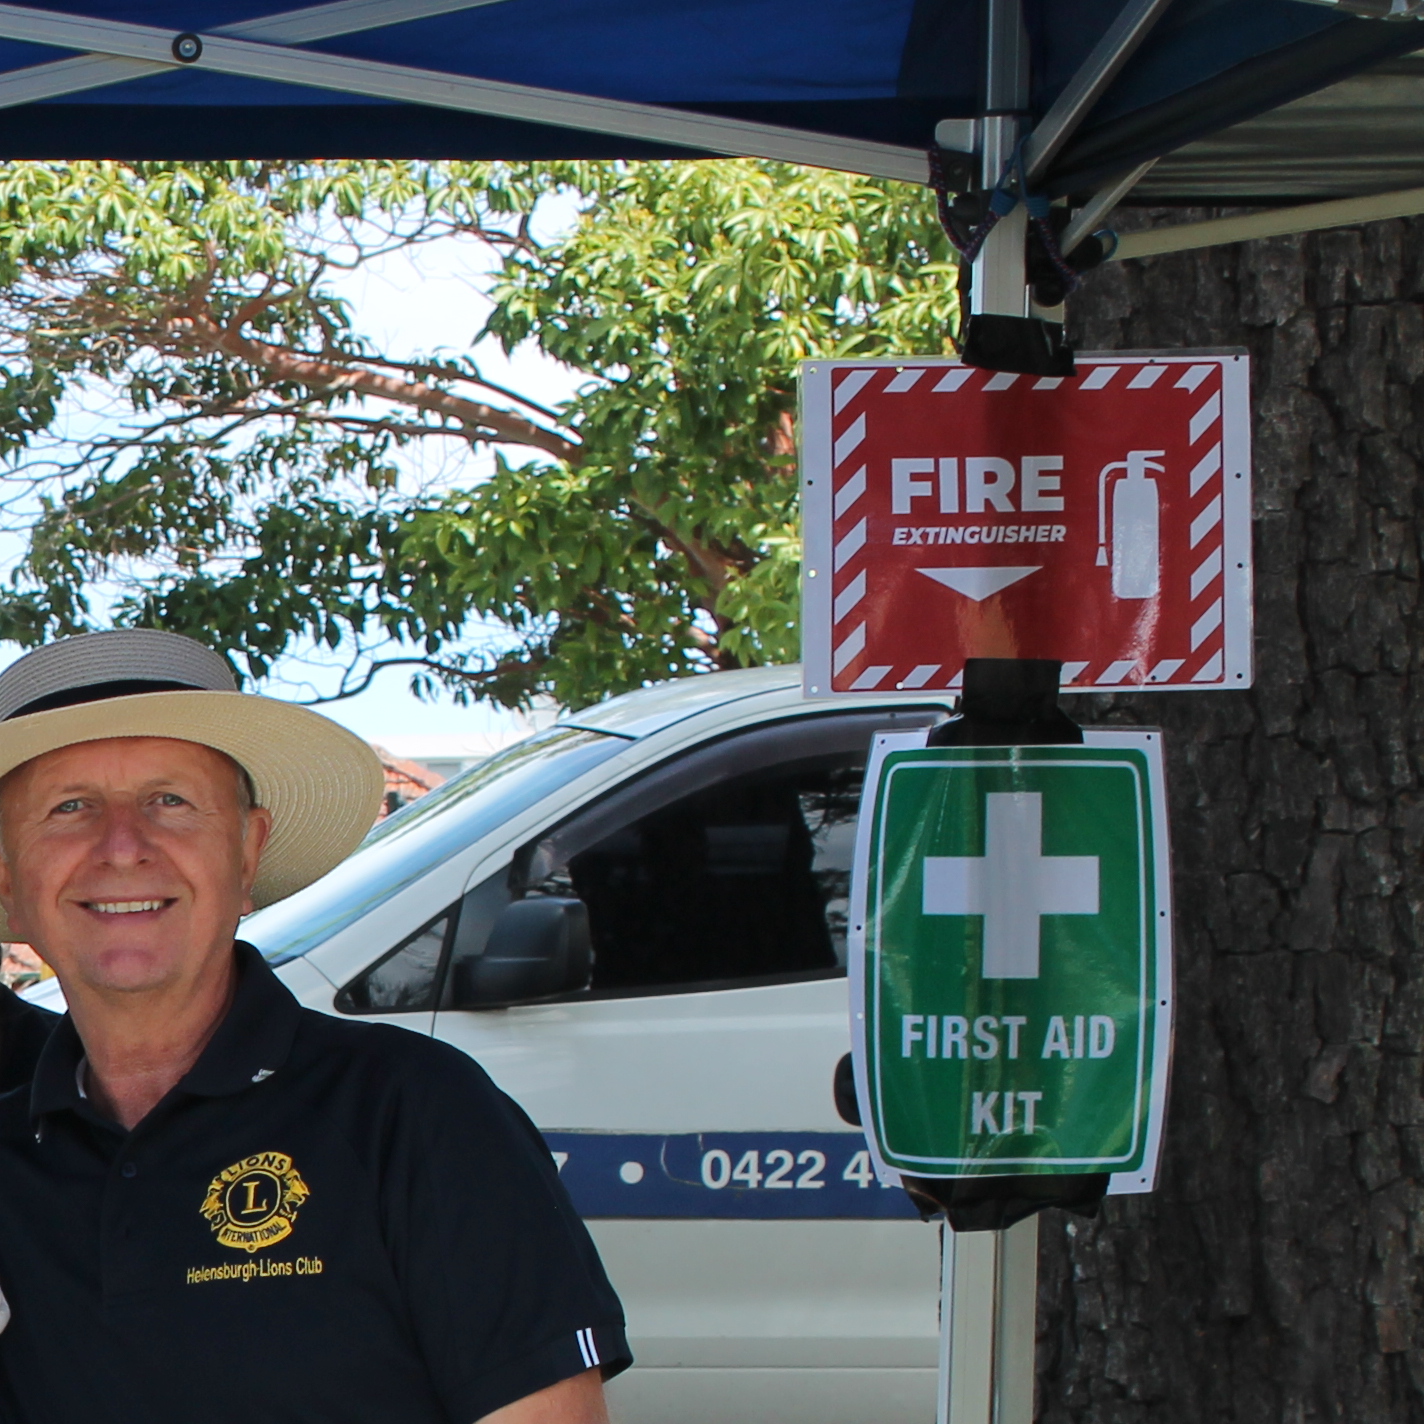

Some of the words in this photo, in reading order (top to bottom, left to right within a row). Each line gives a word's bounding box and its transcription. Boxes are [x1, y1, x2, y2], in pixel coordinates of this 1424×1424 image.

[892, 455, 1064, 514] FIRE
[893, 524, 1067, 545] EXTINGUISHER
[901, 1015, 1026, 1060] FIRST
[1041, 1014, 1115, 1059] AID
[971, 1091, 1043, 1136] KIT
[227, 1153, 287, 1176] LIONS
[702, 1149, 825, 1189] 0422
[843, 1150, 891, 1189] 4
[240, 1180, 267, 1215] L
[186, 1259, 257, 1285] Helensburgh
[259, 1258, 293, 1277] Lions
[295, 1256, 323, 1275] Club
